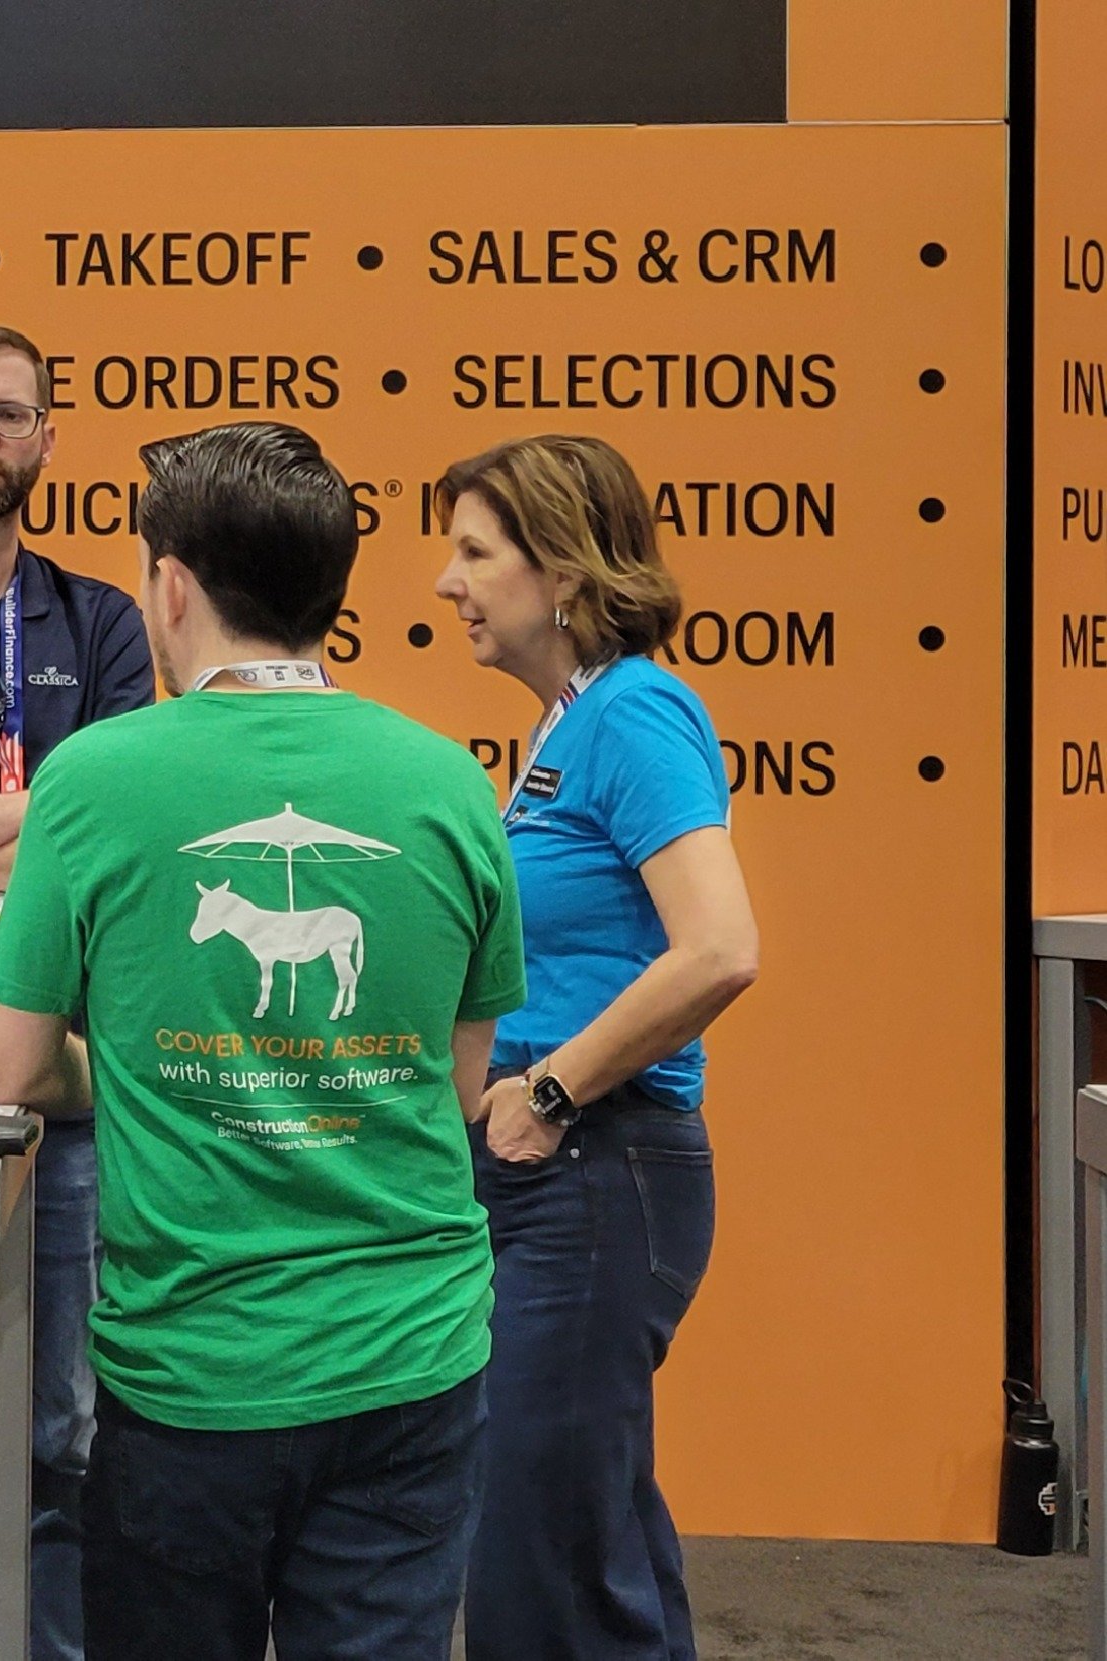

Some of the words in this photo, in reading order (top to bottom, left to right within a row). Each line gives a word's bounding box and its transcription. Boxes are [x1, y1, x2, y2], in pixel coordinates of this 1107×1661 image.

[45, 231, 310, 286] TAKEOFF
[429, 229, 618, 285] SALES
[638, 229, 679, 284] &
[698, 228, 836, 284] CRM
[94, 355, 340, 410] ORDERS
[453, 353, 837, 409] SELECTIONS
[155, 1028, 243, 1058] COVER
[251, 1034, 324, 1060] YOUR
[331, 1033, 422, 1059] ASSETS
[159, 1060, 211, 1085] with
[218, 1068, 309, 1093] superior
[317, 1066, 419, 1090] software.
[217, 1126, 250, 1142] Better
